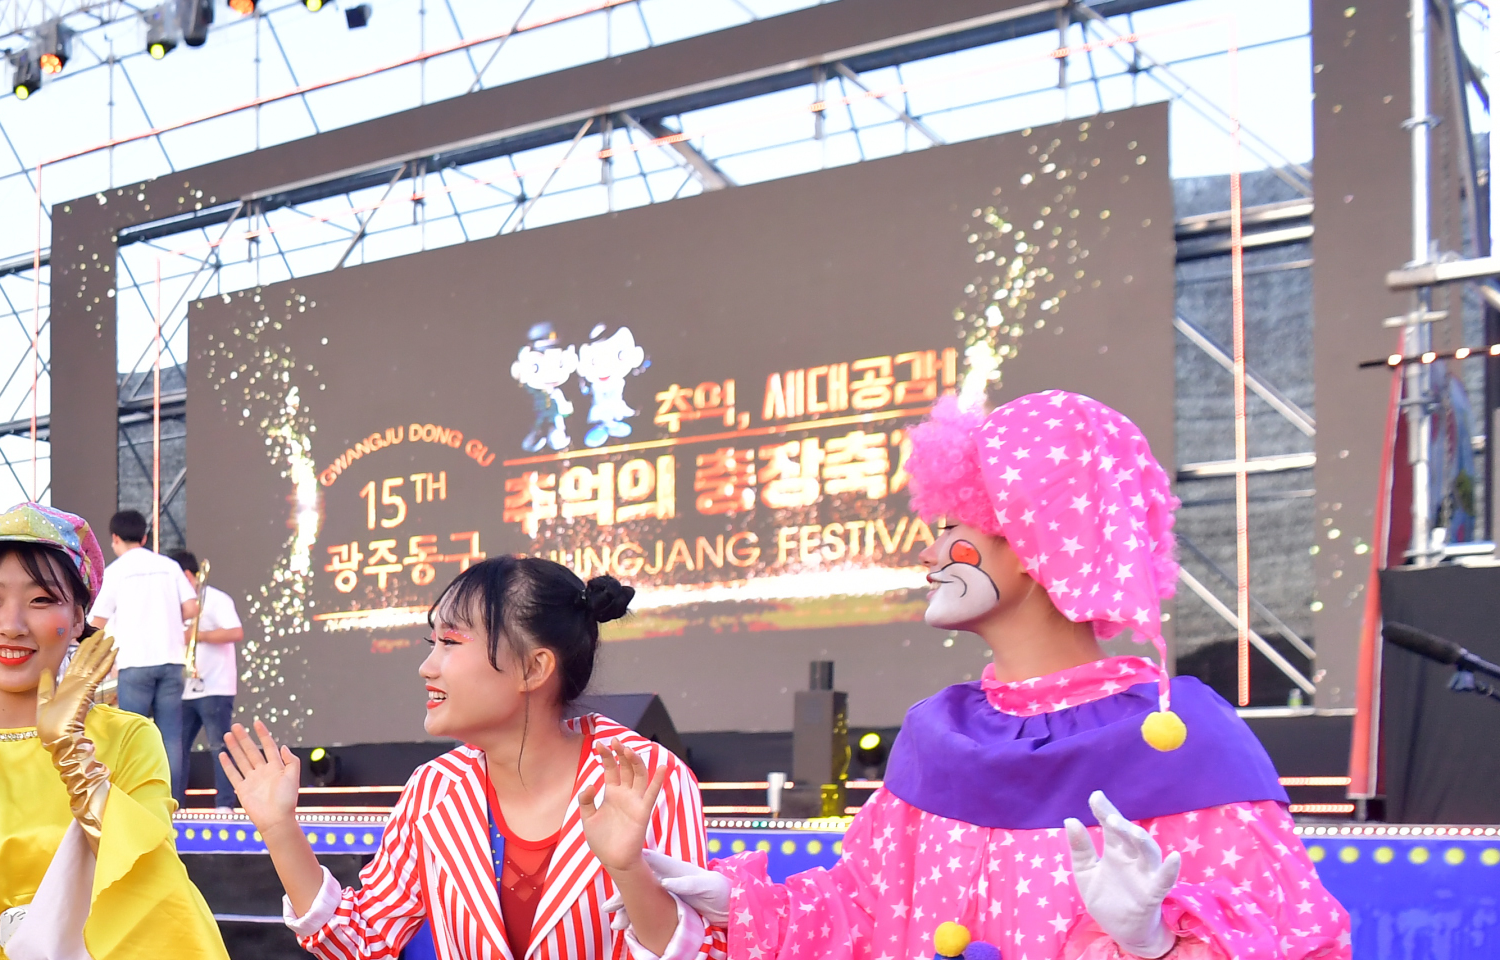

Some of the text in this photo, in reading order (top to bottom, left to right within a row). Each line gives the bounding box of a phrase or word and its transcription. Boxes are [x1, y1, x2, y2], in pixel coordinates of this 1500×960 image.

[654, 347, 957, 433] 추억, 세대공감!
[319, 422, 496, 487] GWANGJU DONG GU
[502, 454, 676, 539] 추억의
[323, 531, 487, 593] 광주동구
